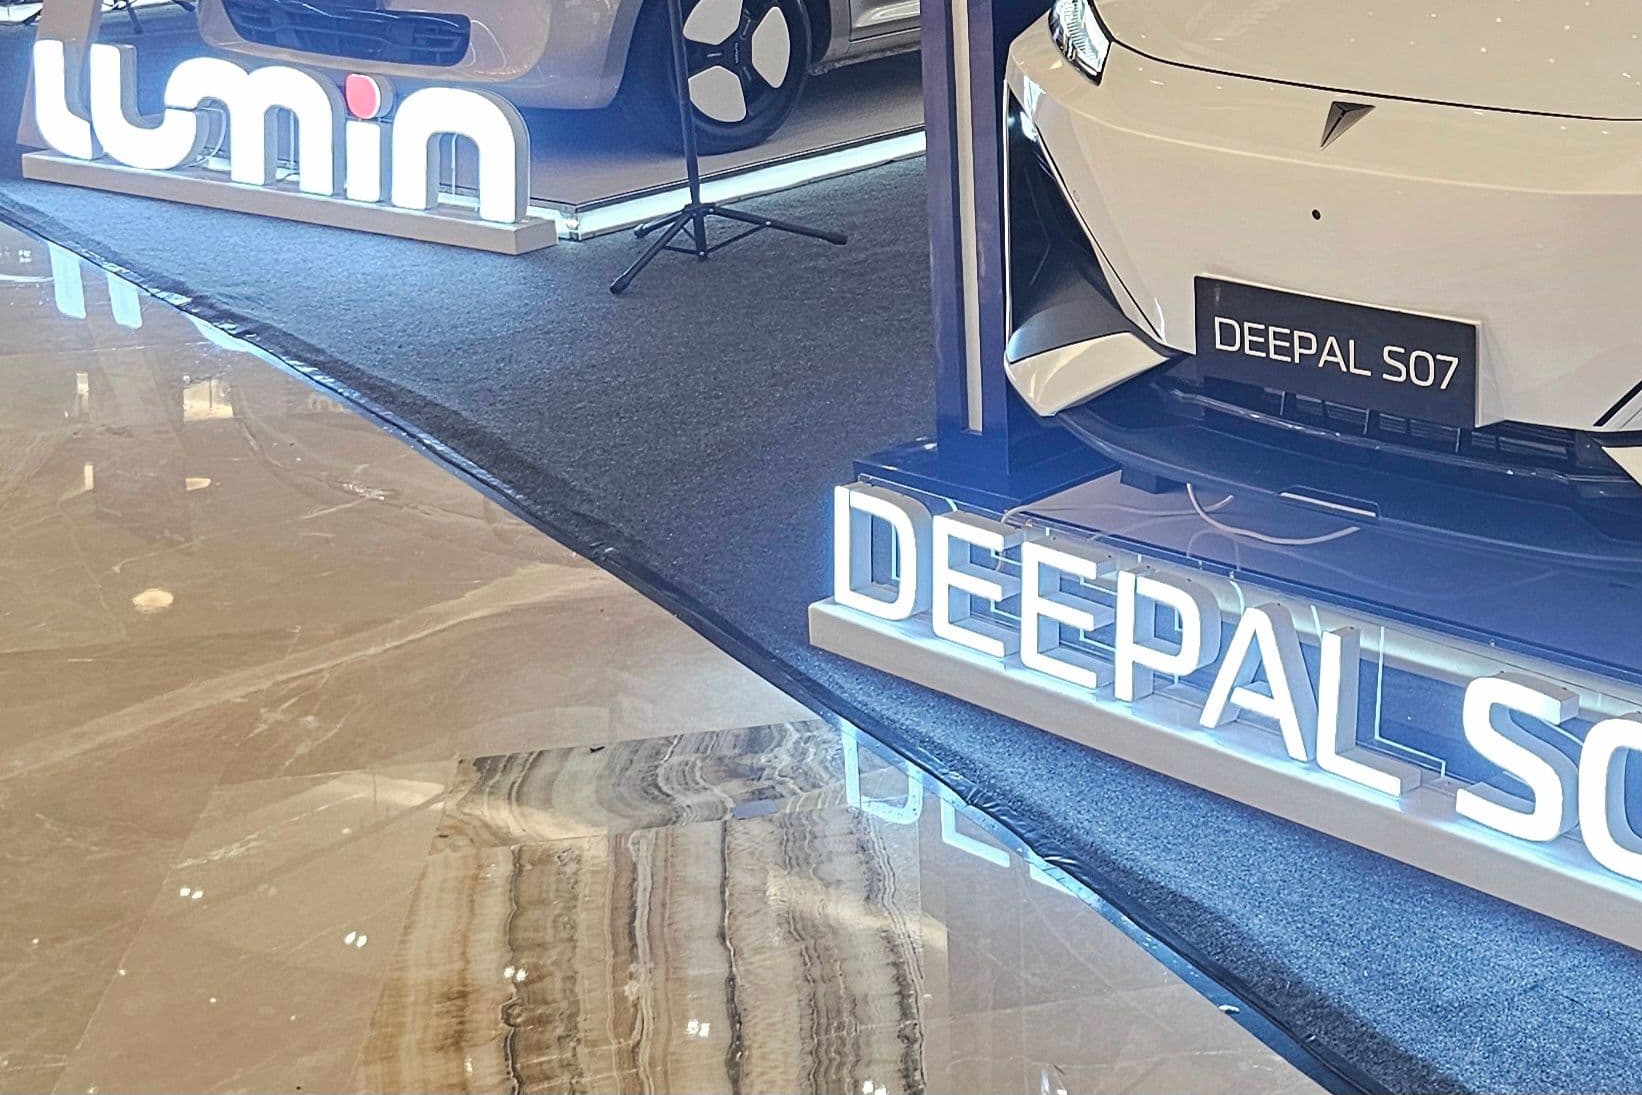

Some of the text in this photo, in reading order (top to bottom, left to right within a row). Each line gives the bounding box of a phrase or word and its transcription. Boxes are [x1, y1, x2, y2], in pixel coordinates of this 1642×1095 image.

[1213, 315, 1459, 390] DEEPAL S07
[833, 484, 1405, 797] DEEPAL
